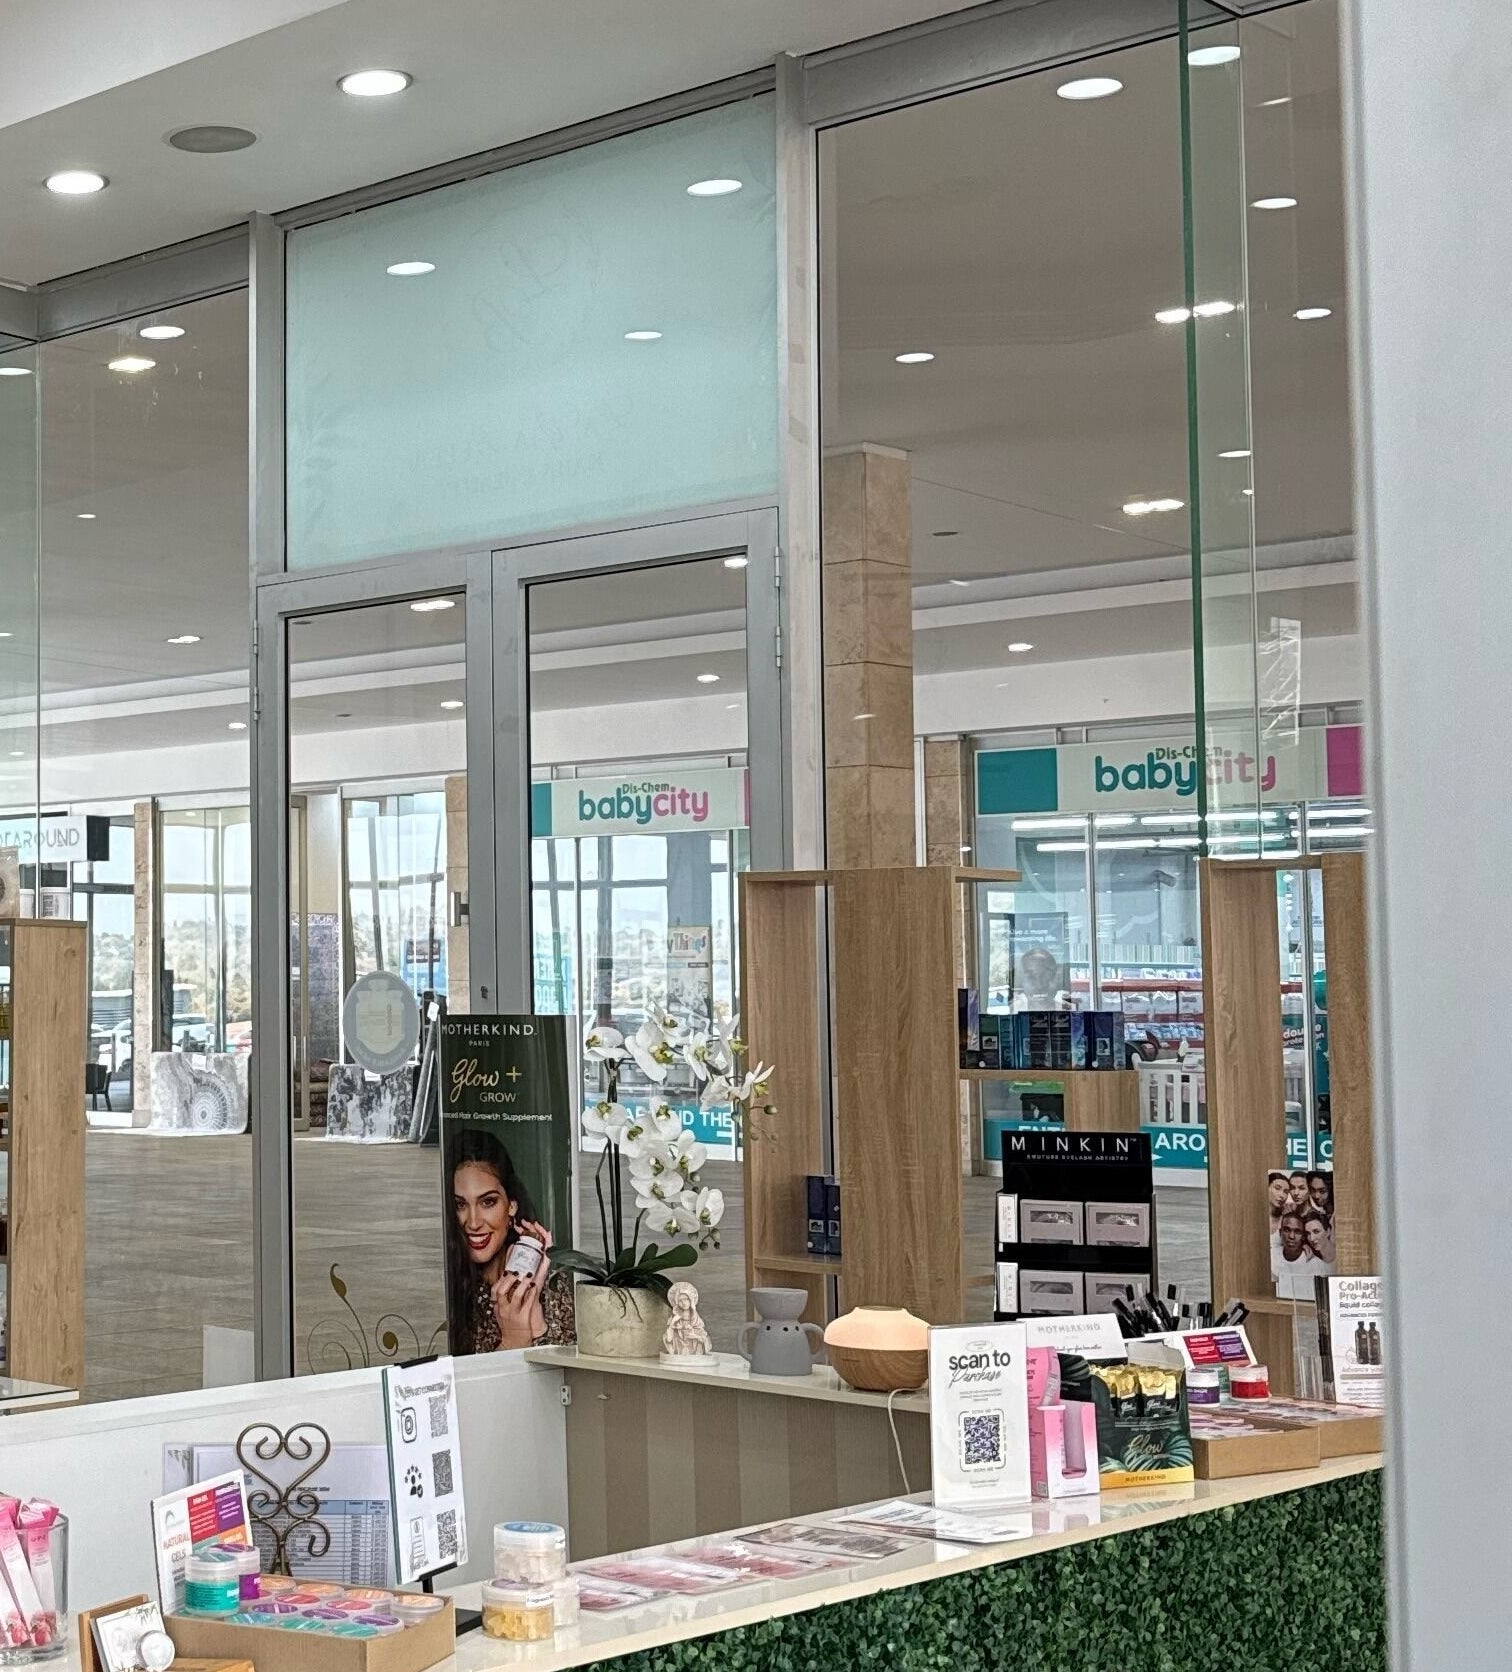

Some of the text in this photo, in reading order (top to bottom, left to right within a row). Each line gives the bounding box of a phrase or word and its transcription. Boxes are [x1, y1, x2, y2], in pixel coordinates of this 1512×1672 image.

[622, 782, 670, 794] Dis-Chem
[579, 786, 709, 825] babycity
[441, 1023, 534, 1036] MOTHERKIND
[450, 1058, 500, 1103] Glow
[479, 1092, 517, 1103] GROW
[473, 1112, 501, 1120] Growth
[502, 1112, 553, 1122] Supplement
[700, 1109, 733, 1128] THE
[1154, 1132, 1207, 1152] ARO
[1338, 1280, 1383, 1292] Collag
[948, 1349, 1011, 1370] scan to
[1127, 1434, 1164, 1457] Glow
[163, 1532, 190, 1549] NATURAL
